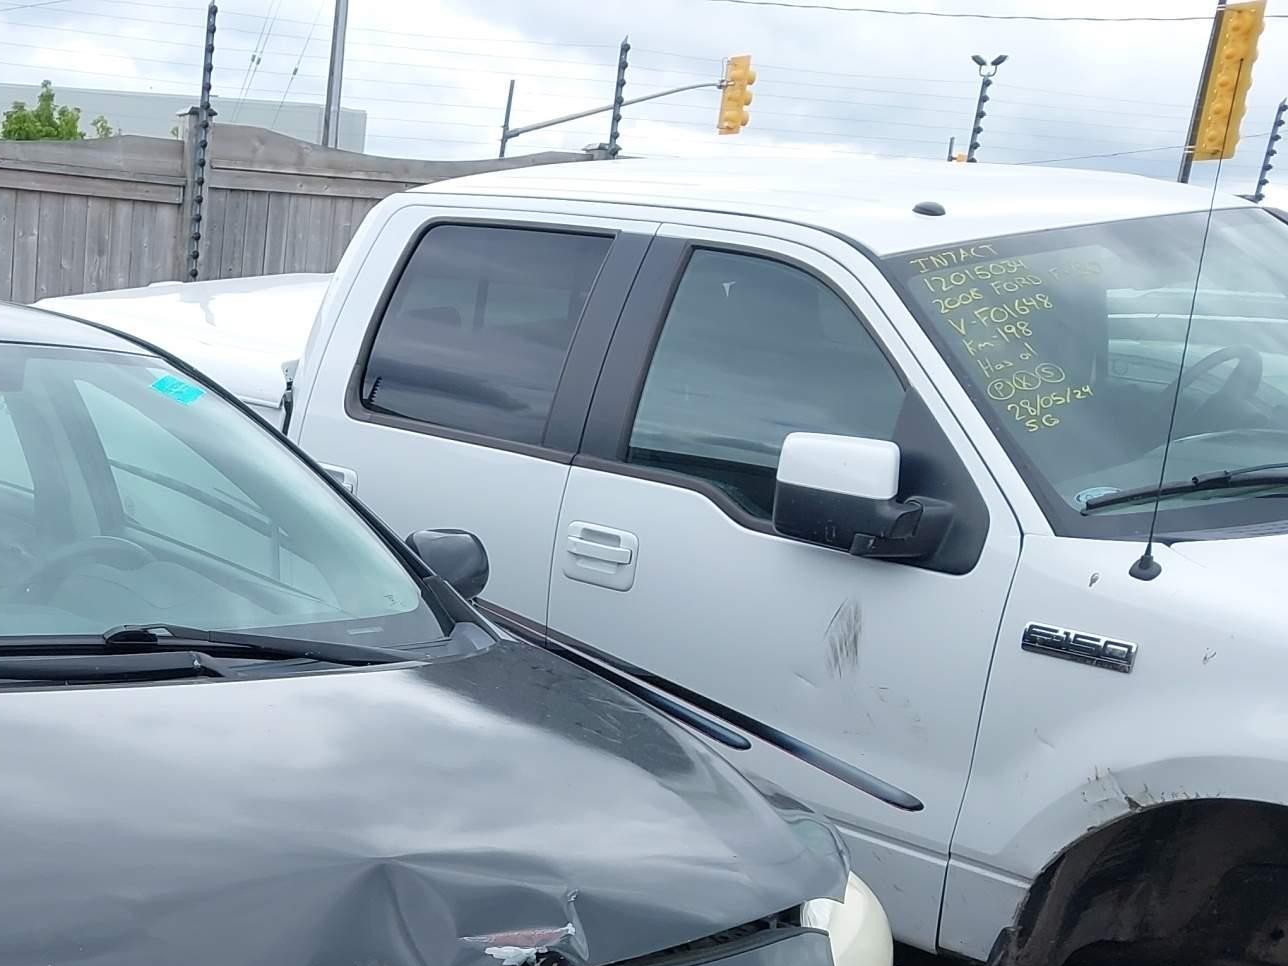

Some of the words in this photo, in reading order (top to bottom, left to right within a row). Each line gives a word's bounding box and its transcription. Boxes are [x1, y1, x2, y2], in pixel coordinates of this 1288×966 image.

[909, 243, 998, 273] INTACT
[923, 258, 1029, 293] 12015034
[989, 274, 1043, 296] FORD
[1007, 384, 1094, 420] 28/05/24
